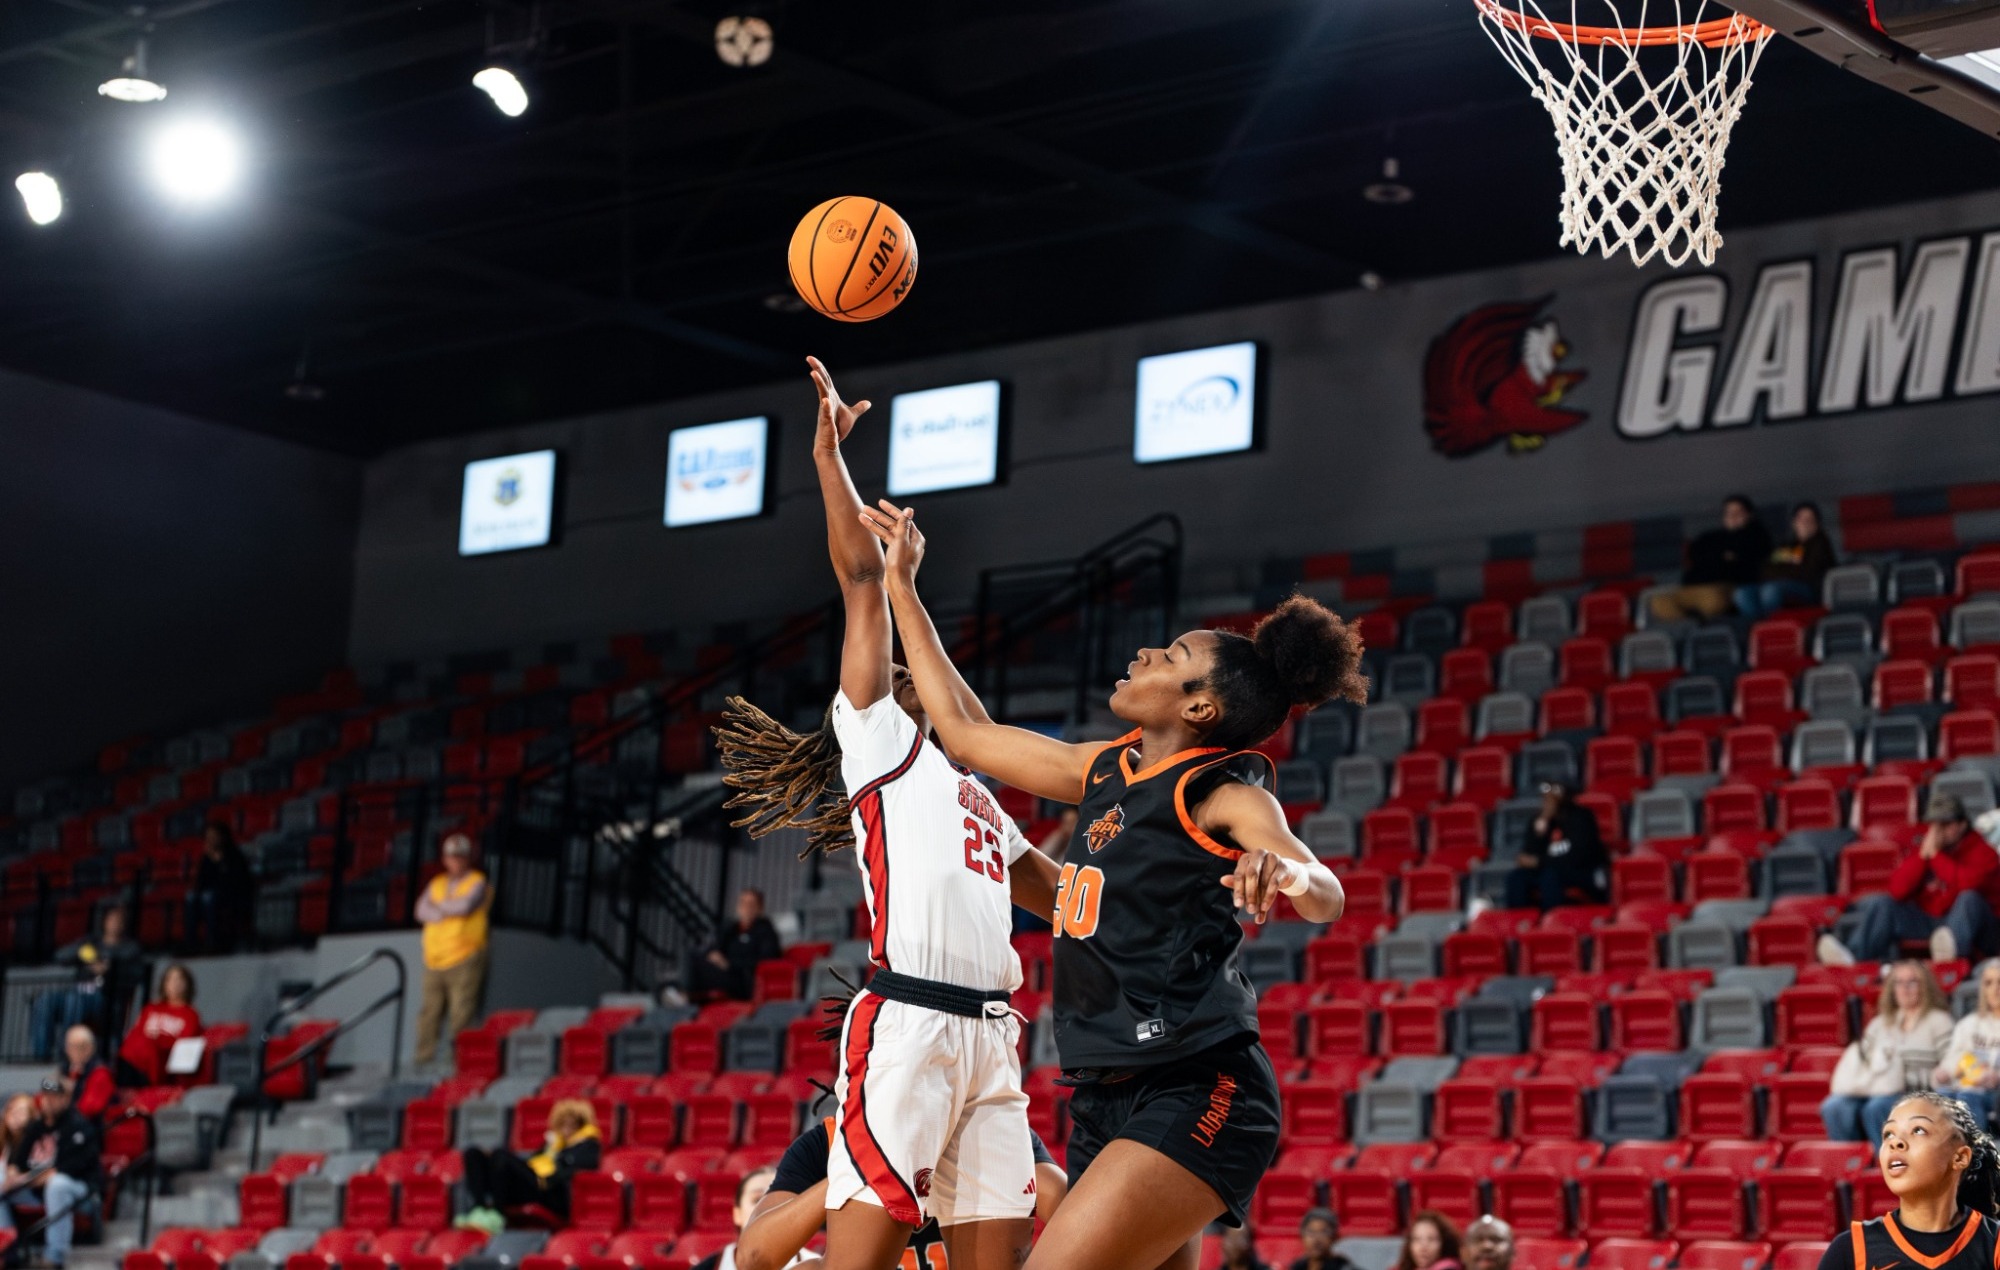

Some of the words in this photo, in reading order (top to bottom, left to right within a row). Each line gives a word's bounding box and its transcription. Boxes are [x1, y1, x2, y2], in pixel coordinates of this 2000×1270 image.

[869, 225, 898, 278] EVO
[963, 816, 1005, 885] 23
[1087, 820, 1122, 839] BPC
[1053, 861, 1106, 941] 30
[1150, 1023, 1161, 1034] XL
